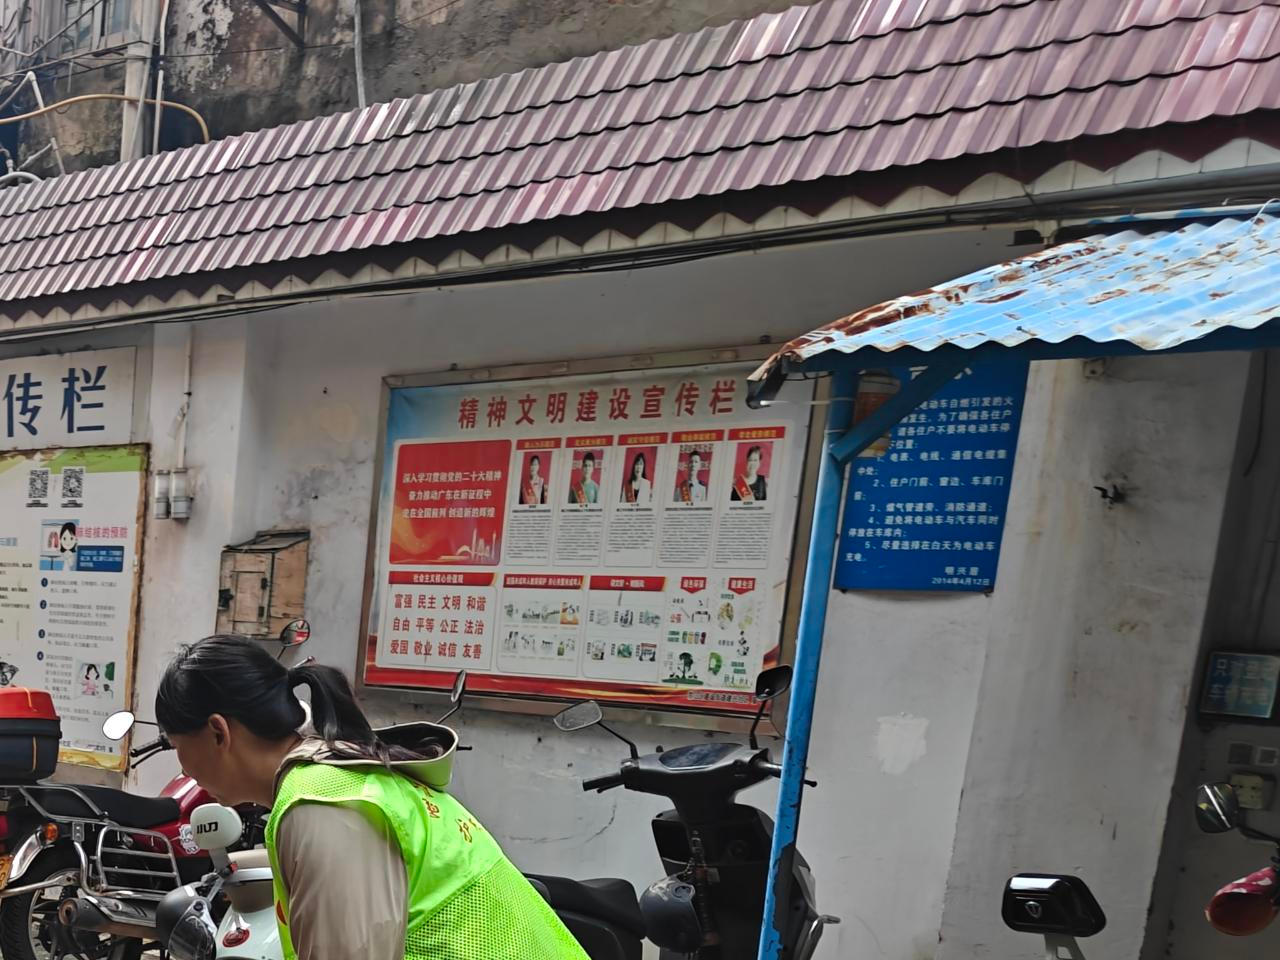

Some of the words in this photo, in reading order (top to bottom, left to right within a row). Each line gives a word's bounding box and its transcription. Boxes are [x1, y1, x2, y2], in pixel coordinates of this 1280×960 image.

[458, 379, 737, 430] 精神文明建设宣传栏
[394, 594, 413, 609] 富强
[417, 594, 437, 610] 民主
[441, 595, 461, 611] 文明
[466, 596, 487, 611] 和谐
[392, 617, 410, 632] 自由
[416, 618, 434, 633] 平等
[440, 619, 459, 634] 公正
[464, 619, 484, 635] 法治
[390, 640, 409, 655] 爱国
[414, 640, 432, 656] 敬业
[438, 642, 457, 658] 诚信
[463, 643, 482, 659] 友善
